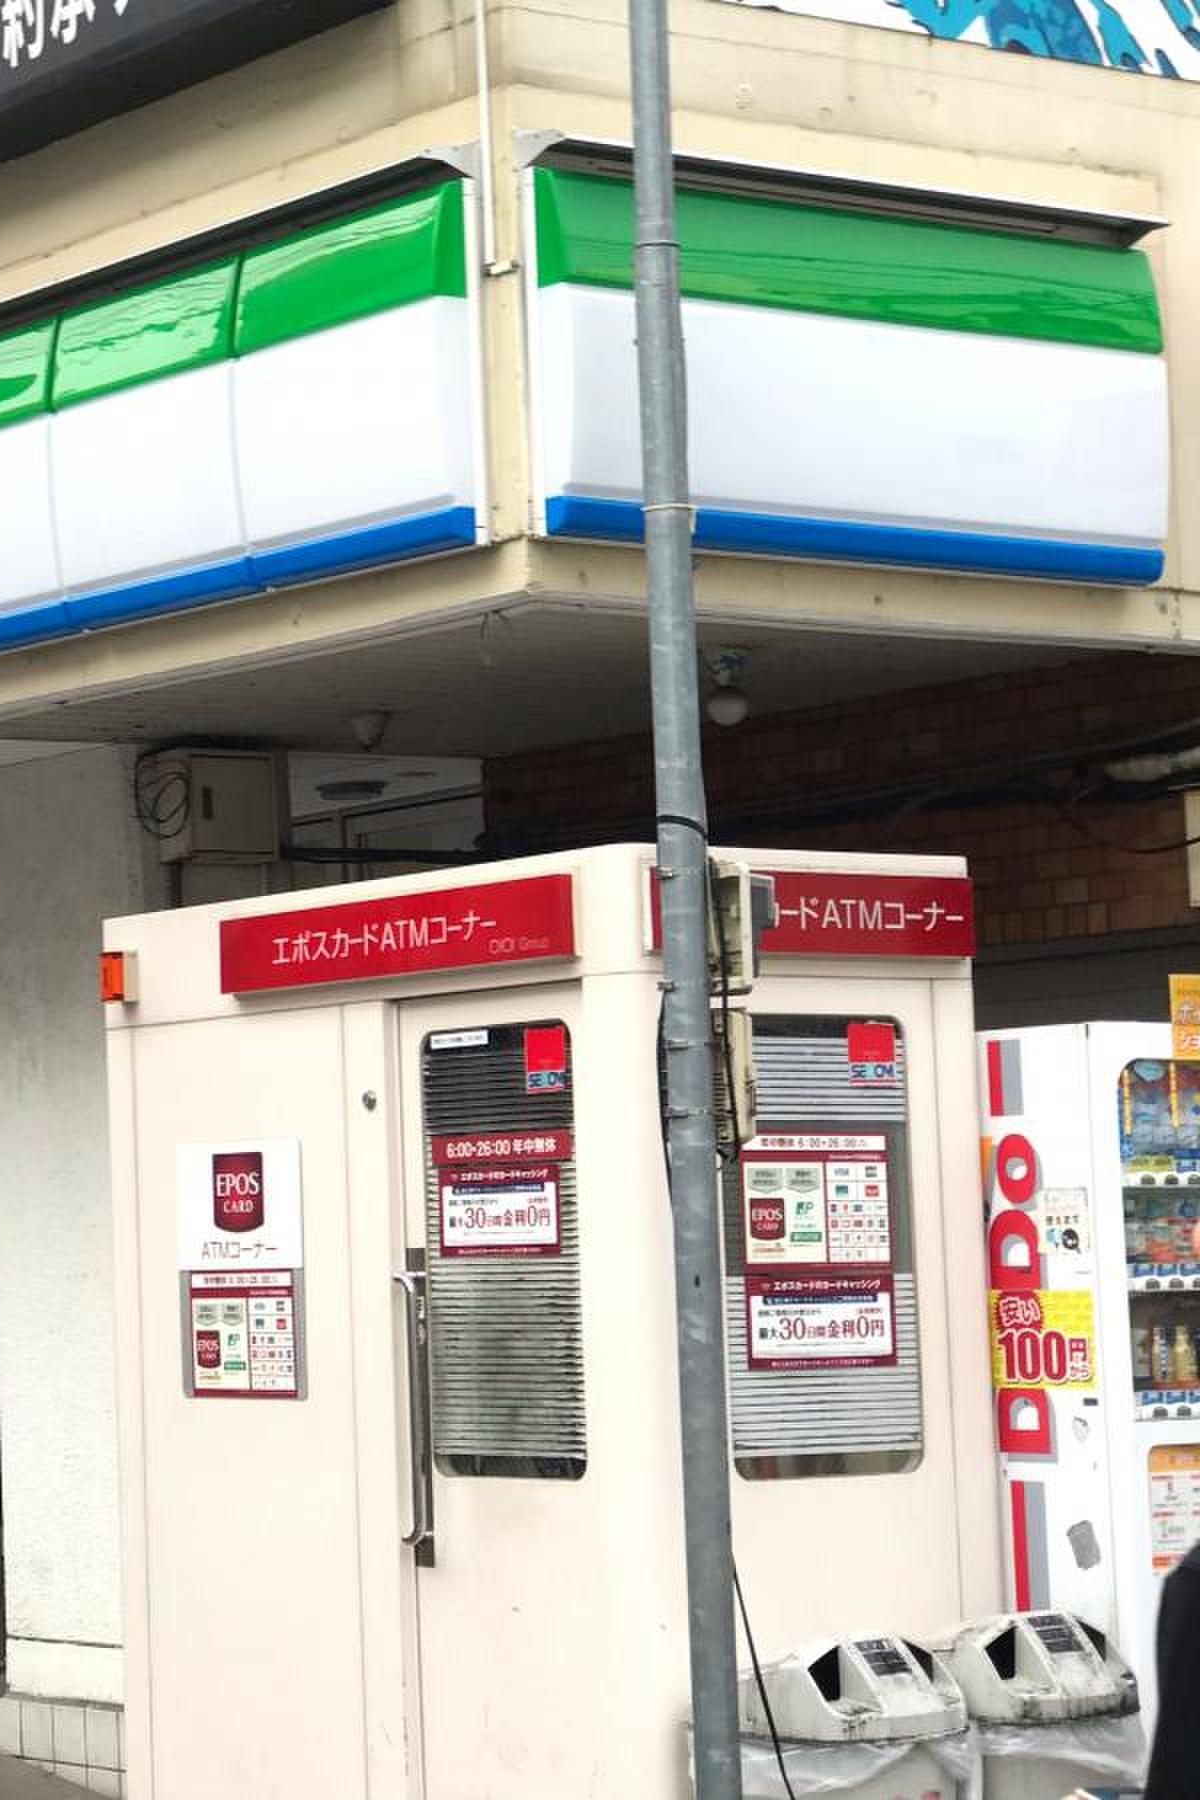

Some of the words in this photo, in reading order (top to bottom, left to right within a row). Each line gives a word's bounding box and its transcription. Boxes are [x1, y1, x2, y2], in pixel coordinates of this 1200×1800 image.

[774, 896, 965, 931] ードATMコーナー
[271, 910, 497, 966] エポスカードATMコーナー
[216, 1171, 260, 1197] EPOS
[223, 1199, 255, 1213] CARD
[201, 1239, 279, 1260] ATMコーナー
